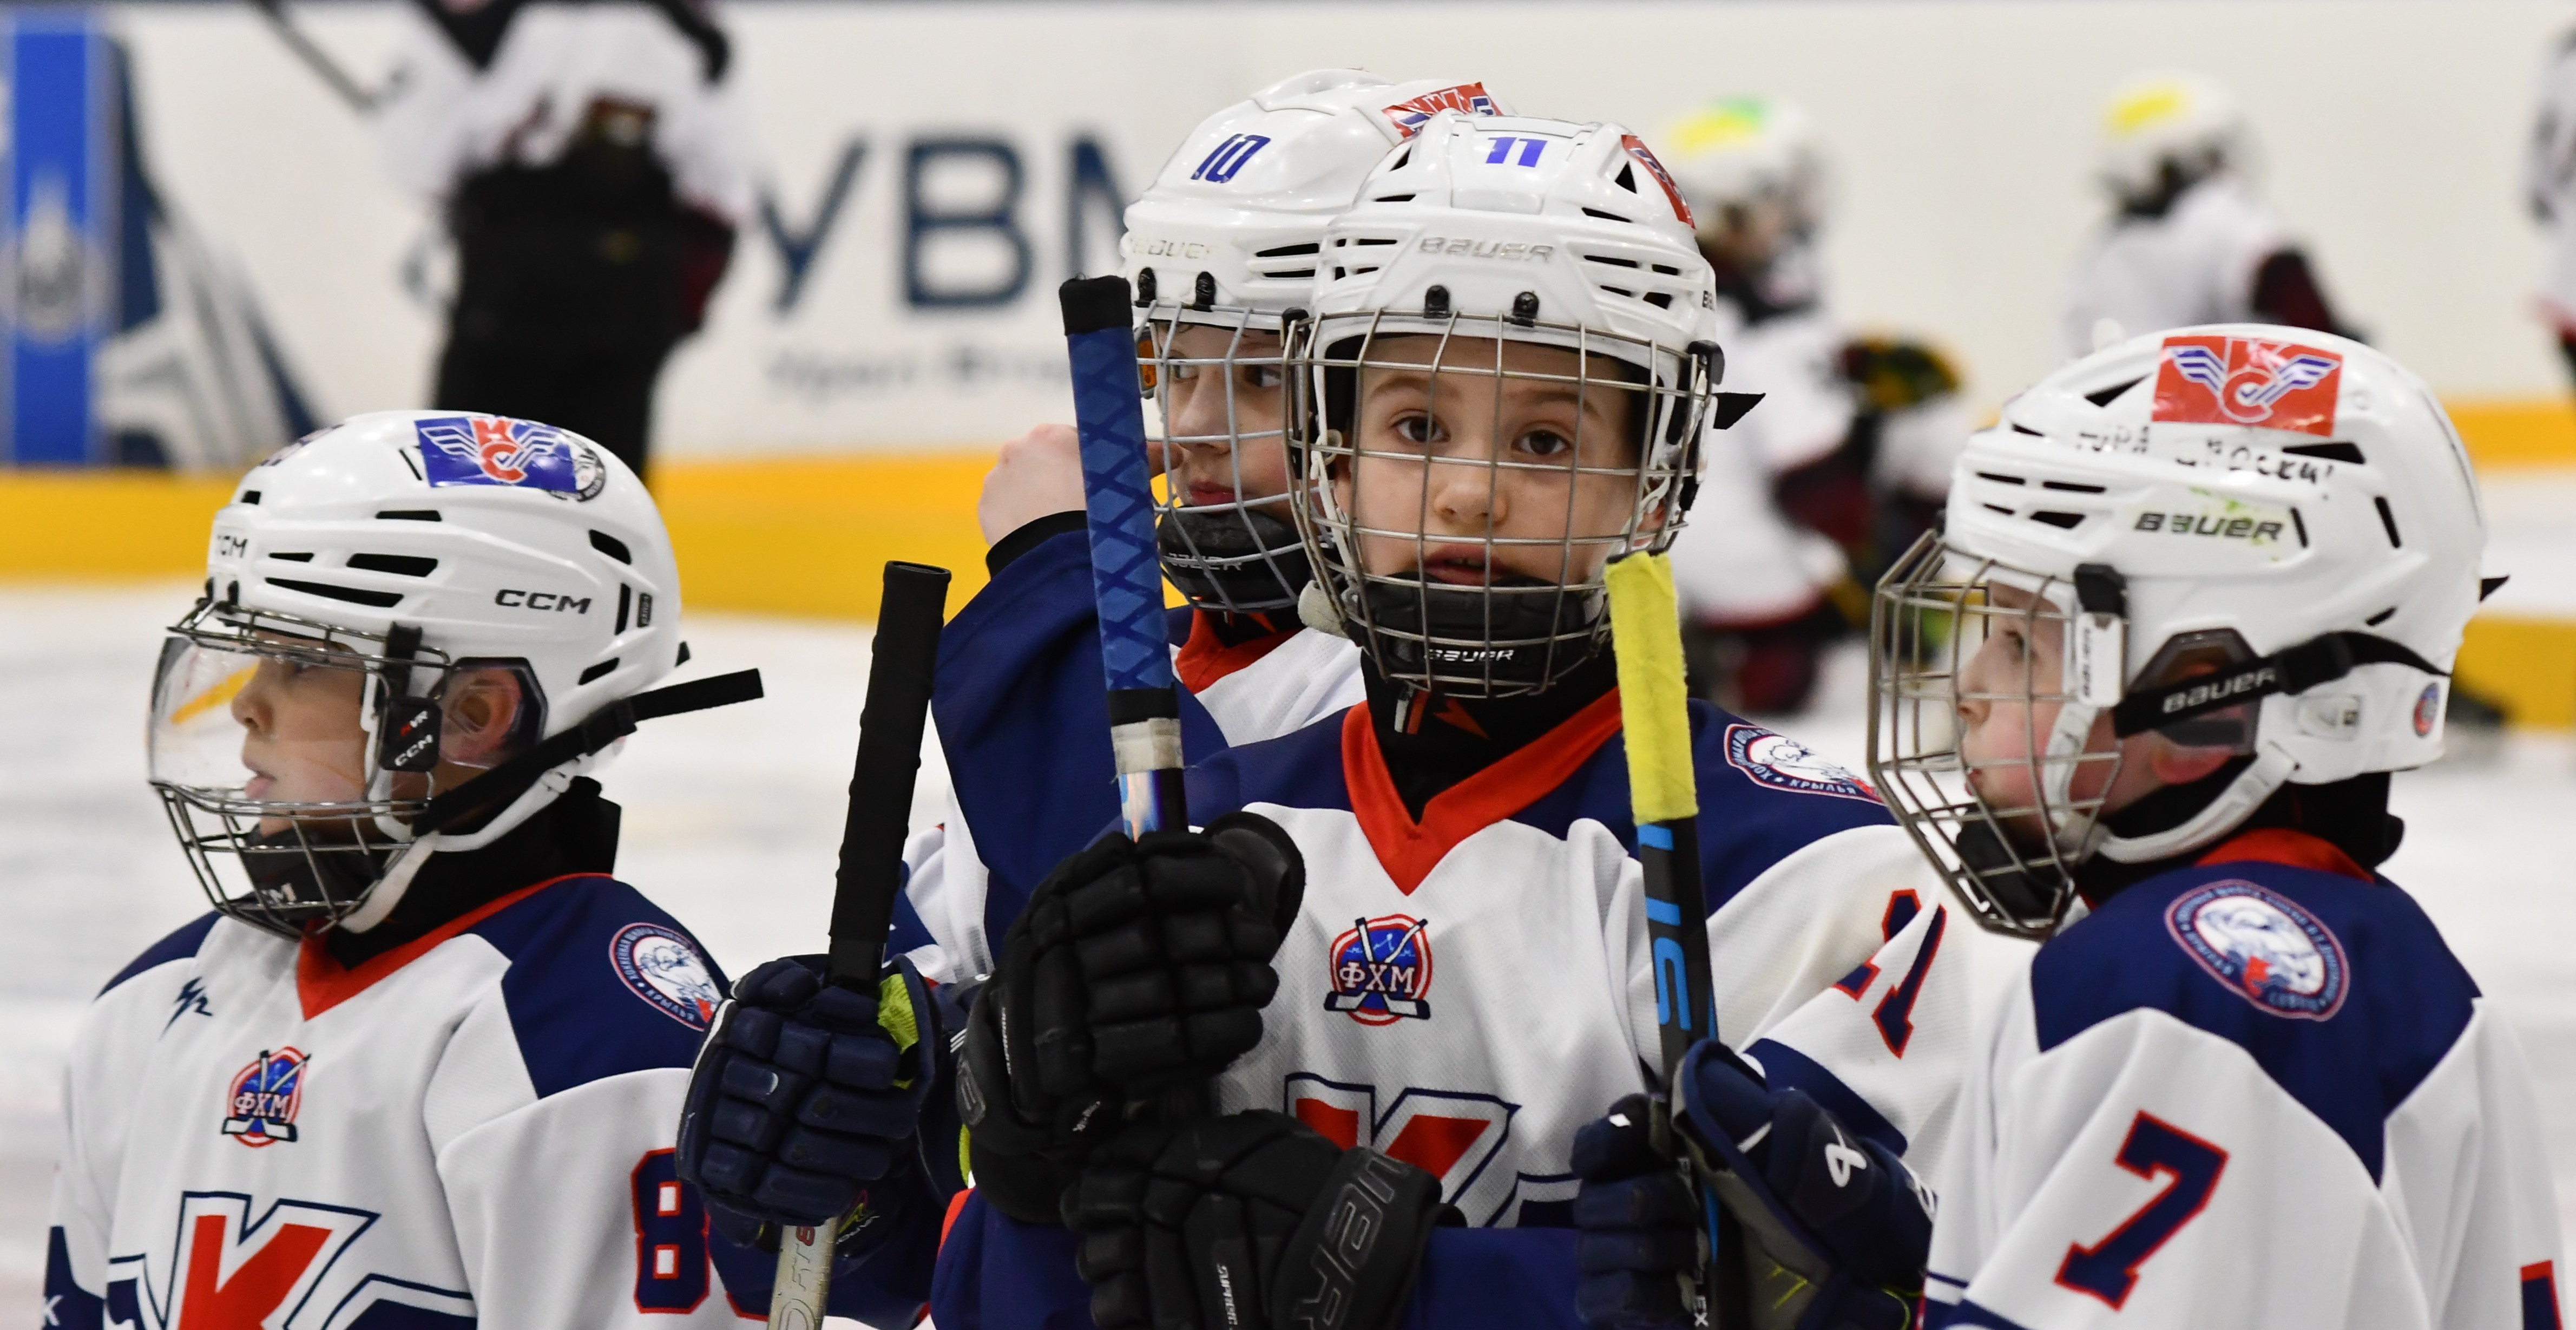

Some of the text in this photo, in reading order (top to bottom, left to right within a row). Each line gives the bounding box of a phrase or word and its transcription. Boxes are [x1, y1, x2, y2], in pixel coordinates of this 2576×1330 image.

[1191, 133, 1272, 184] 10
[1486, 136, 1547, 167] 11
[1418, 237, 1554, 263] BAUER
[2133, 510, 2286, 542] BAUER
[495, 588, 593, 615] CCM
[2162, 667, 2276, 713] BAUER
[394, 733, 434, 766] CCM
[1339, 961, 1416, 994] ФХМ
[233, 1091, 291, 1119] ФХМ
[2053, 1110, 2230, 1312] 7
